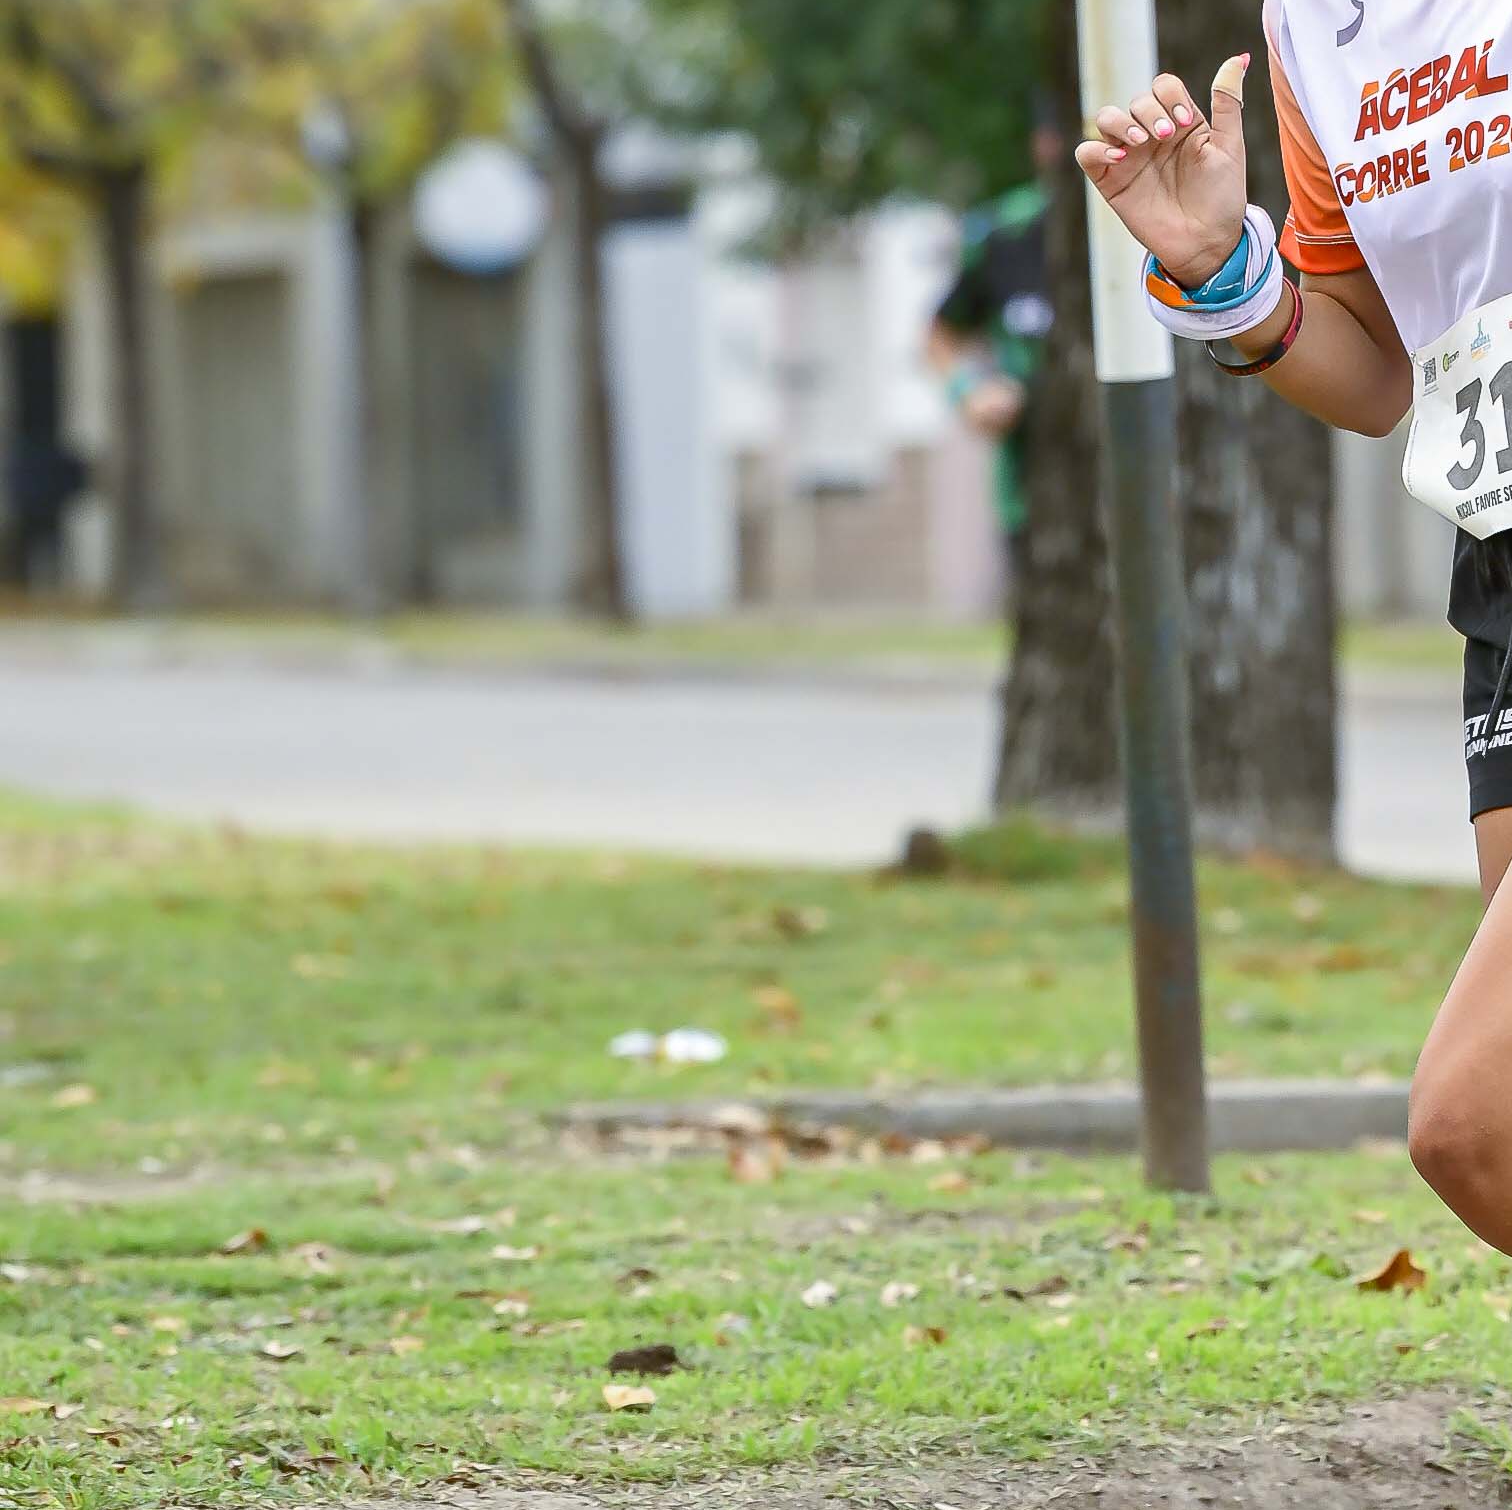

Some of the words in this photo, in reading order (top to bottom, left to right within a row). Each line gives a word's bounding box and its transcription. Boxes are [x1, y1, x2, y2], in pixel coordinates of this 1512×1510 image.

[1354, 38, 1508, 141] ACEBAL
[1334, 139, 1429, 207] CORRE
[1475, 489, 1502, 512] FAIVRE
